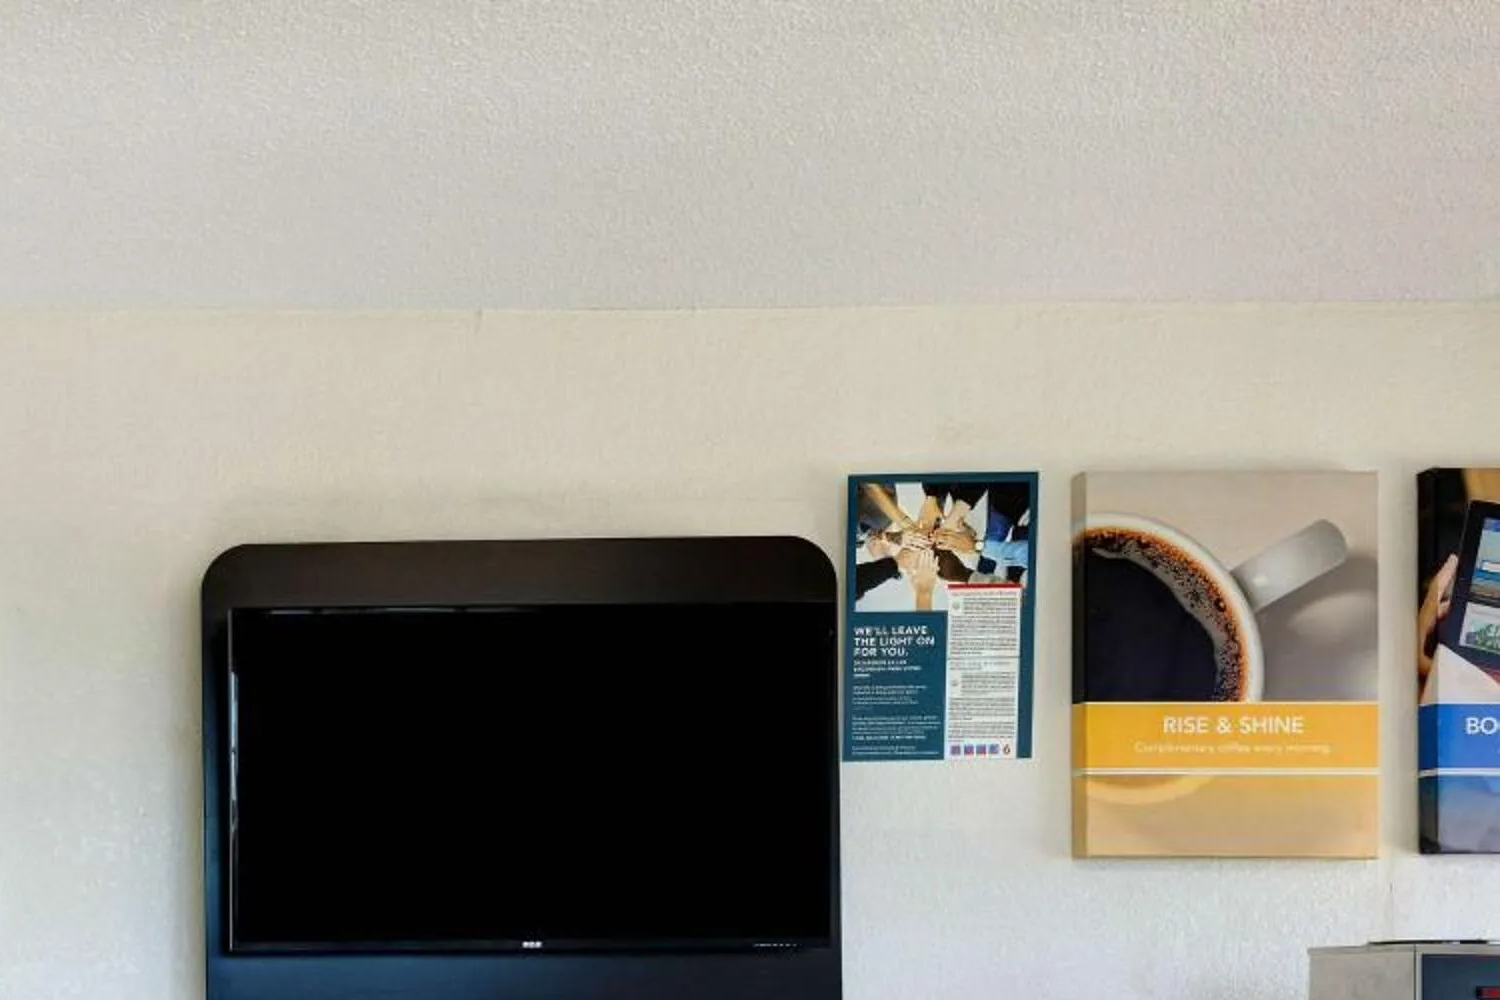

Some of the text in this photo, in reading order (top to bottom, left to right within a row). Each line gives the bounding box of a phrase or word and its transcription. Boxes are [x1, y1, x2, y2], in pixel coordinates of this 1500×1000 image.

[853, 625, 928, 636] WE'LL LEAVE
[854, 635, 935, 646] THE LIGHT ON
[854, 648, 877, 657] FOR
[1163, 716, 1304, 733] RISE & SHINE
[1466, 717, 1500, 734] BO
